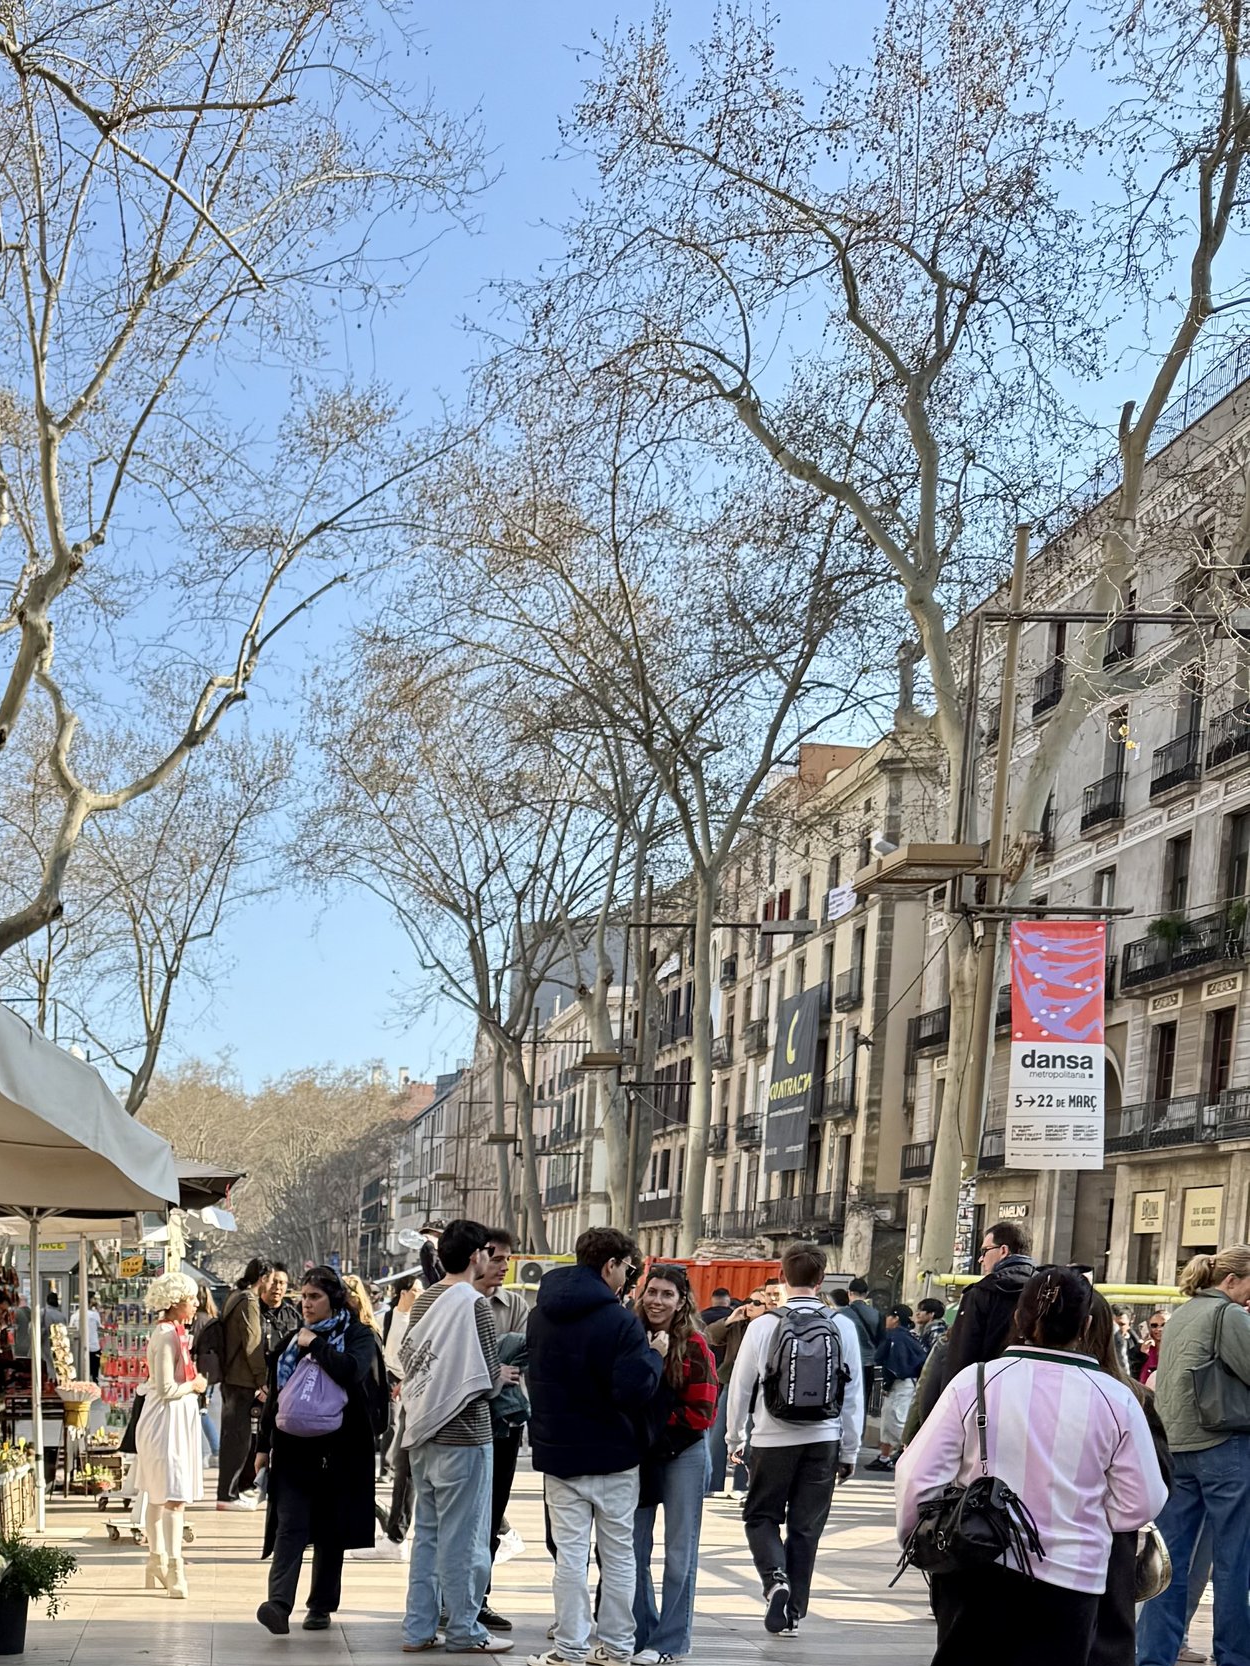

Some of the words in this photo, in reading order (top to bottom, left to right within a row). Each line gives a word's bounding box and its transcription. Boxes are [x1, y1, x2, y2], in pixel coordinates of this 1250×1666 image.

[1021, 1049, 1093, 1070] dansa
[1029, 1070, 1086, 1079] metropolitana
[1056, 1098, 1066, 1108] DE
[1068, 1094, 1098, 1112] MARÇ
